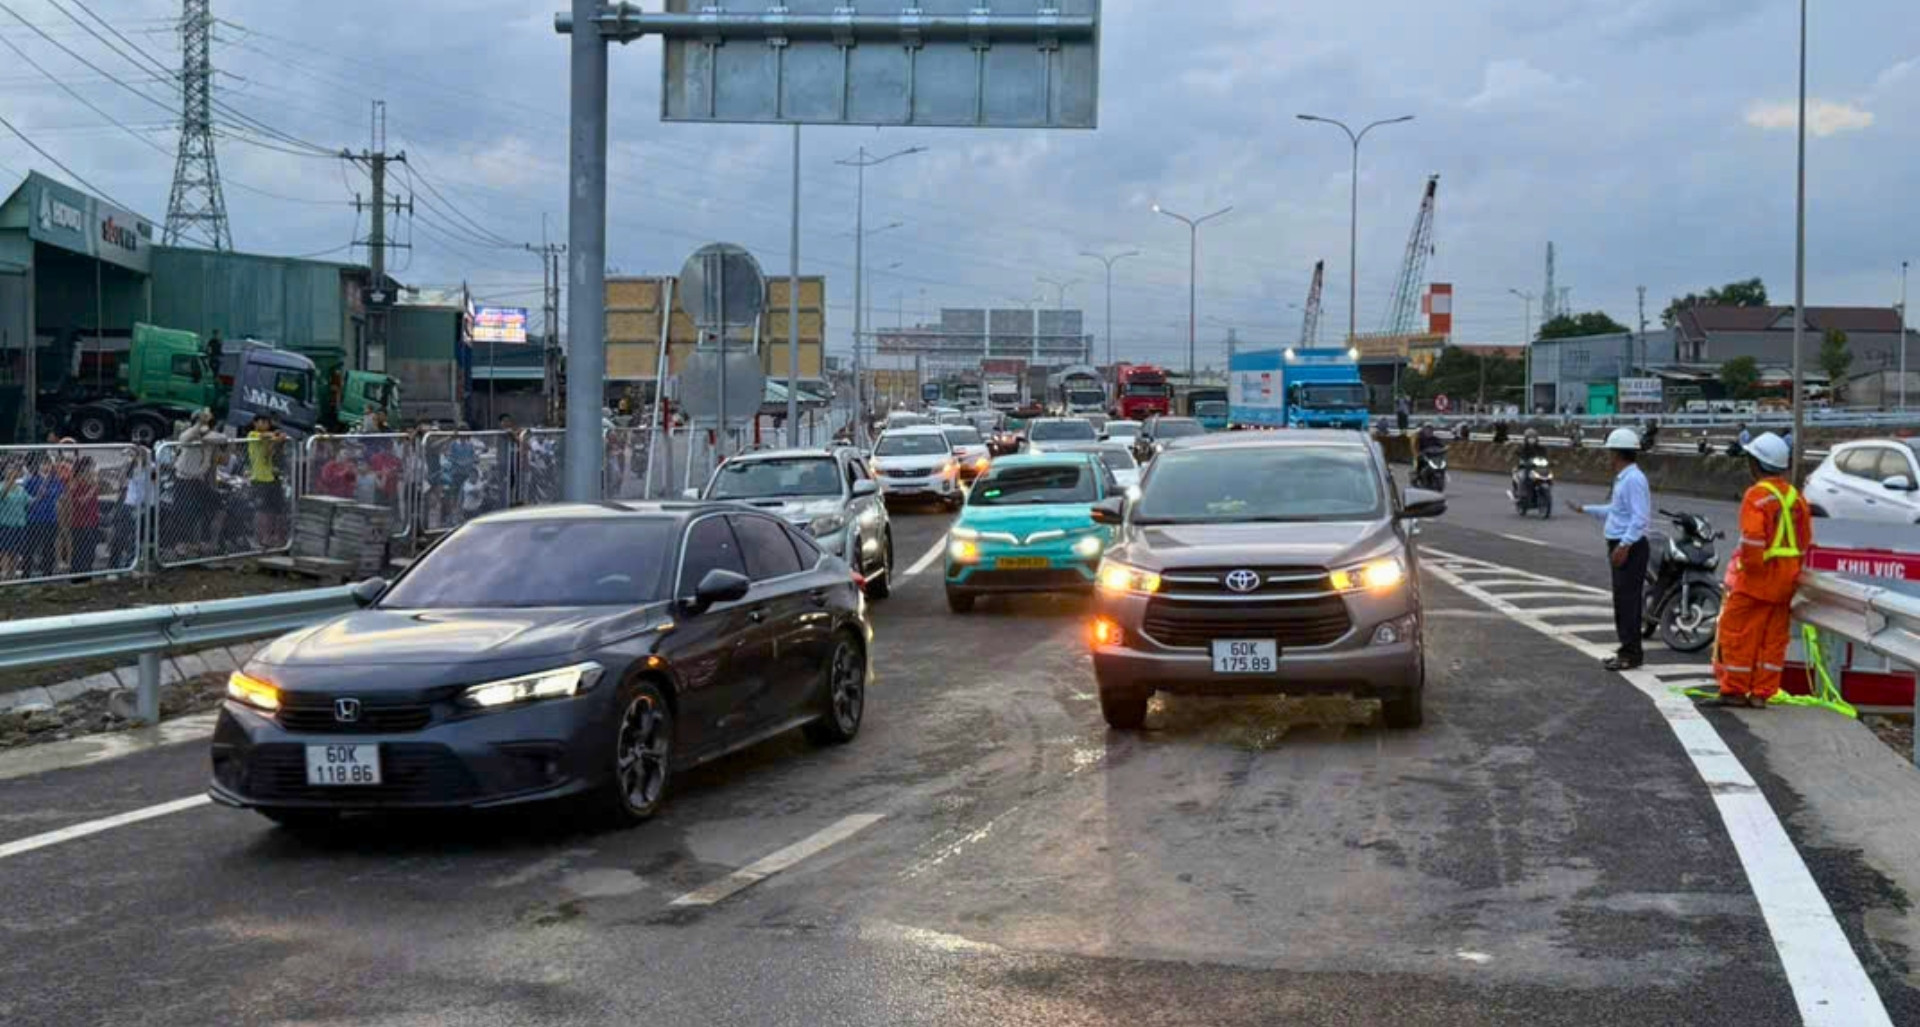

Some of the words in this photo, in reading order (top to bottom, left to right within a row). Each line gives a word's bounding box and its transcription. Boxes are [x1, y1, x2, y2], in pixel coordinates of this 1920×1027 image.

[1837, 559, 1870, 575] KHU
[1230, 642, 1258, 655] 60K
[1220, 656, 1271, 671] 175.89
[327, 745, 358, 763] 60K
[317, 764, 375, 783] 118.86
